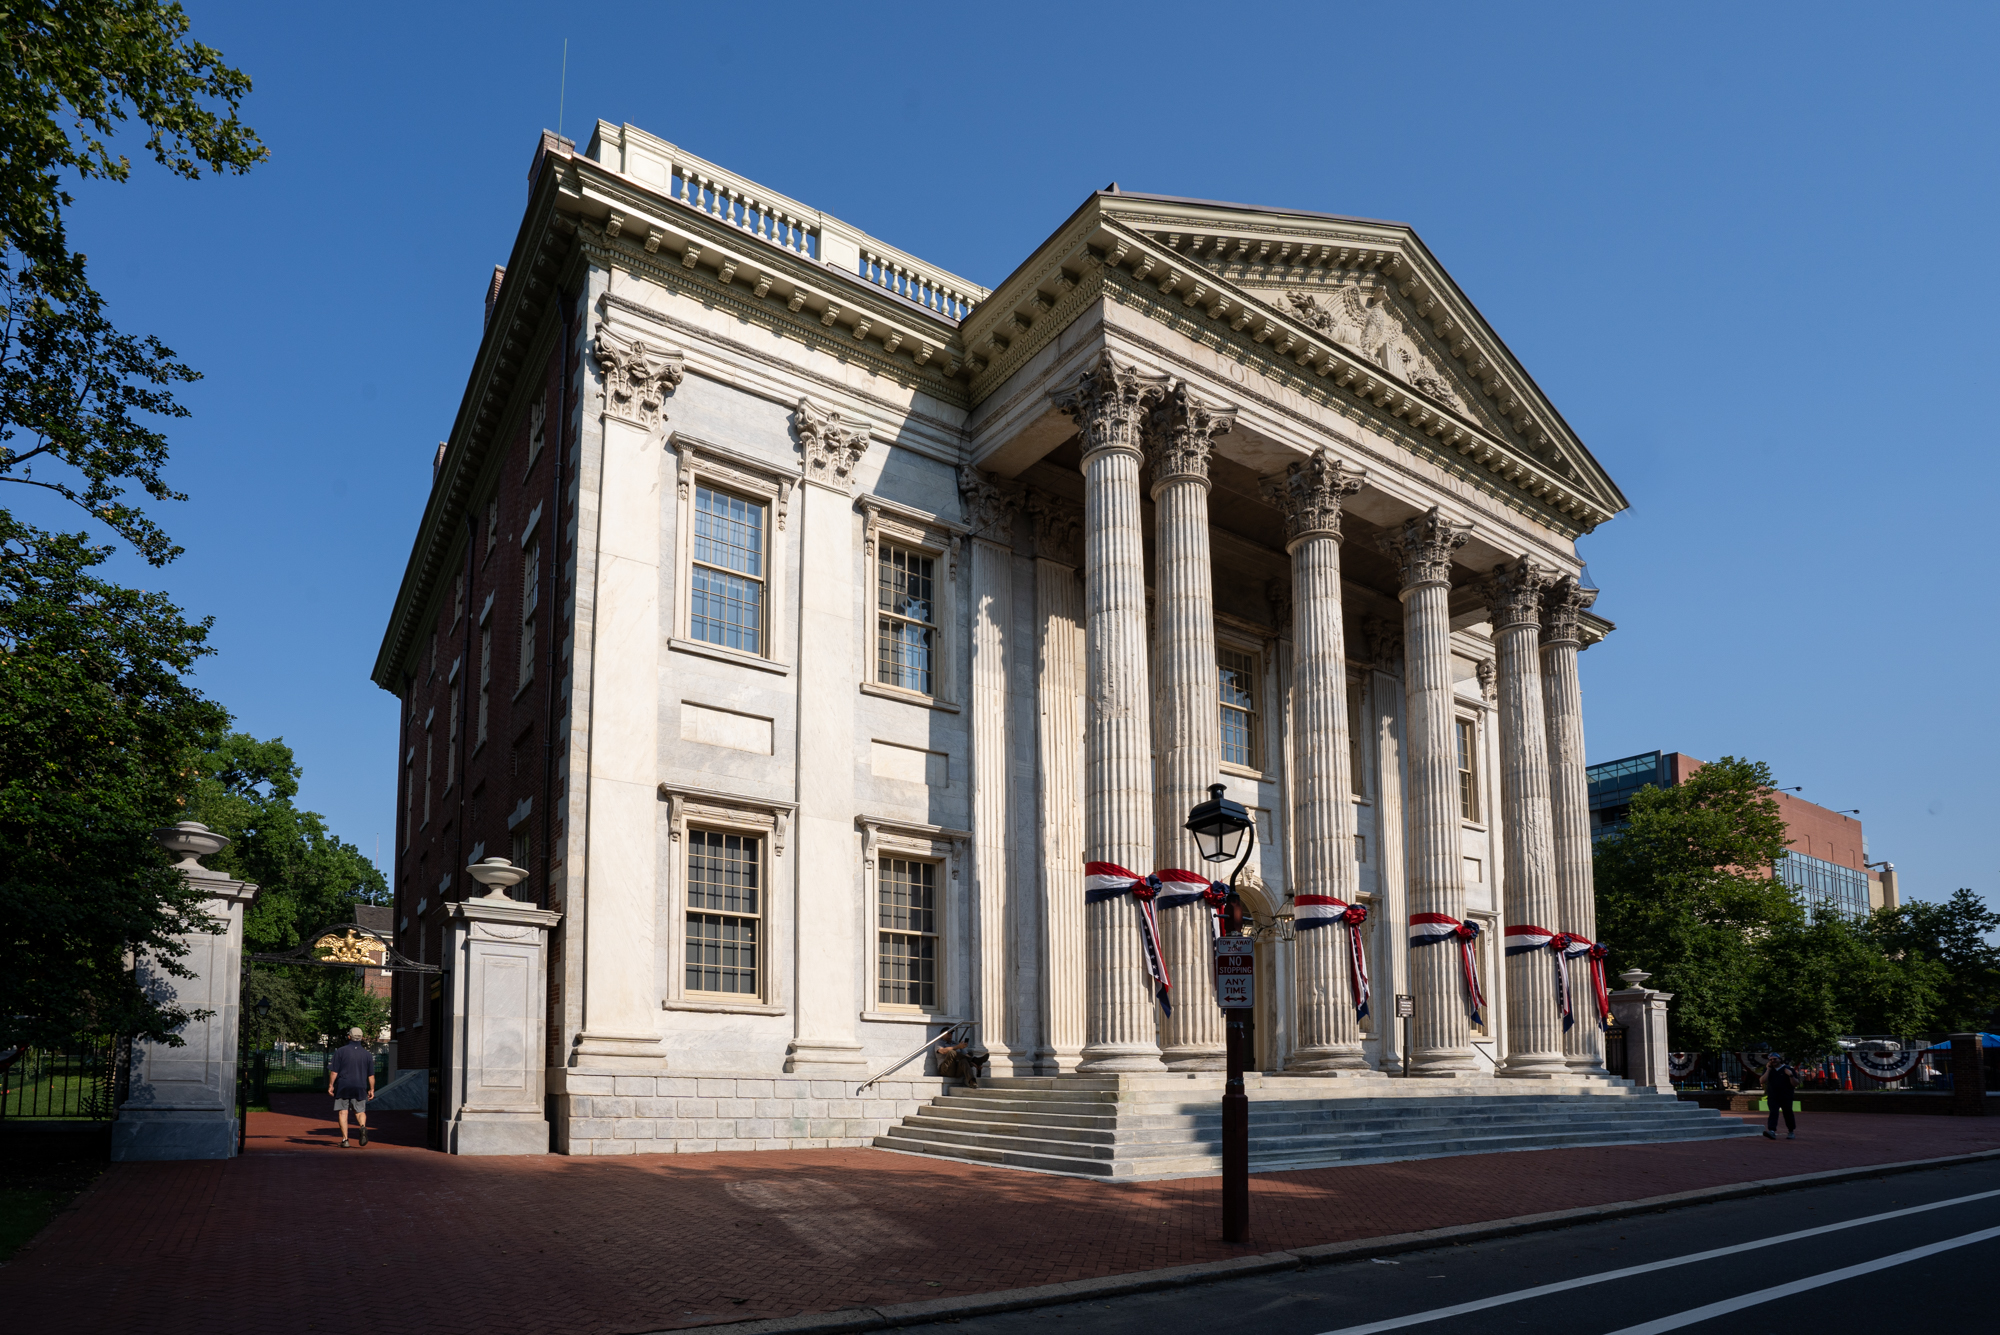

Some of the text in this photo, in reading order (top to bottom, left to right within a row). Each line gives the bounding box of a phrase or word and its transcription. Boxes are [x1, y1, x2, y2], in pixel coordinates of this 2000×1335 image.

[1214, 353, 1322, 422] FOUNDED
[1229, 956, 1242, 966] NO
[1225, 978, 1246, 986] ANY
